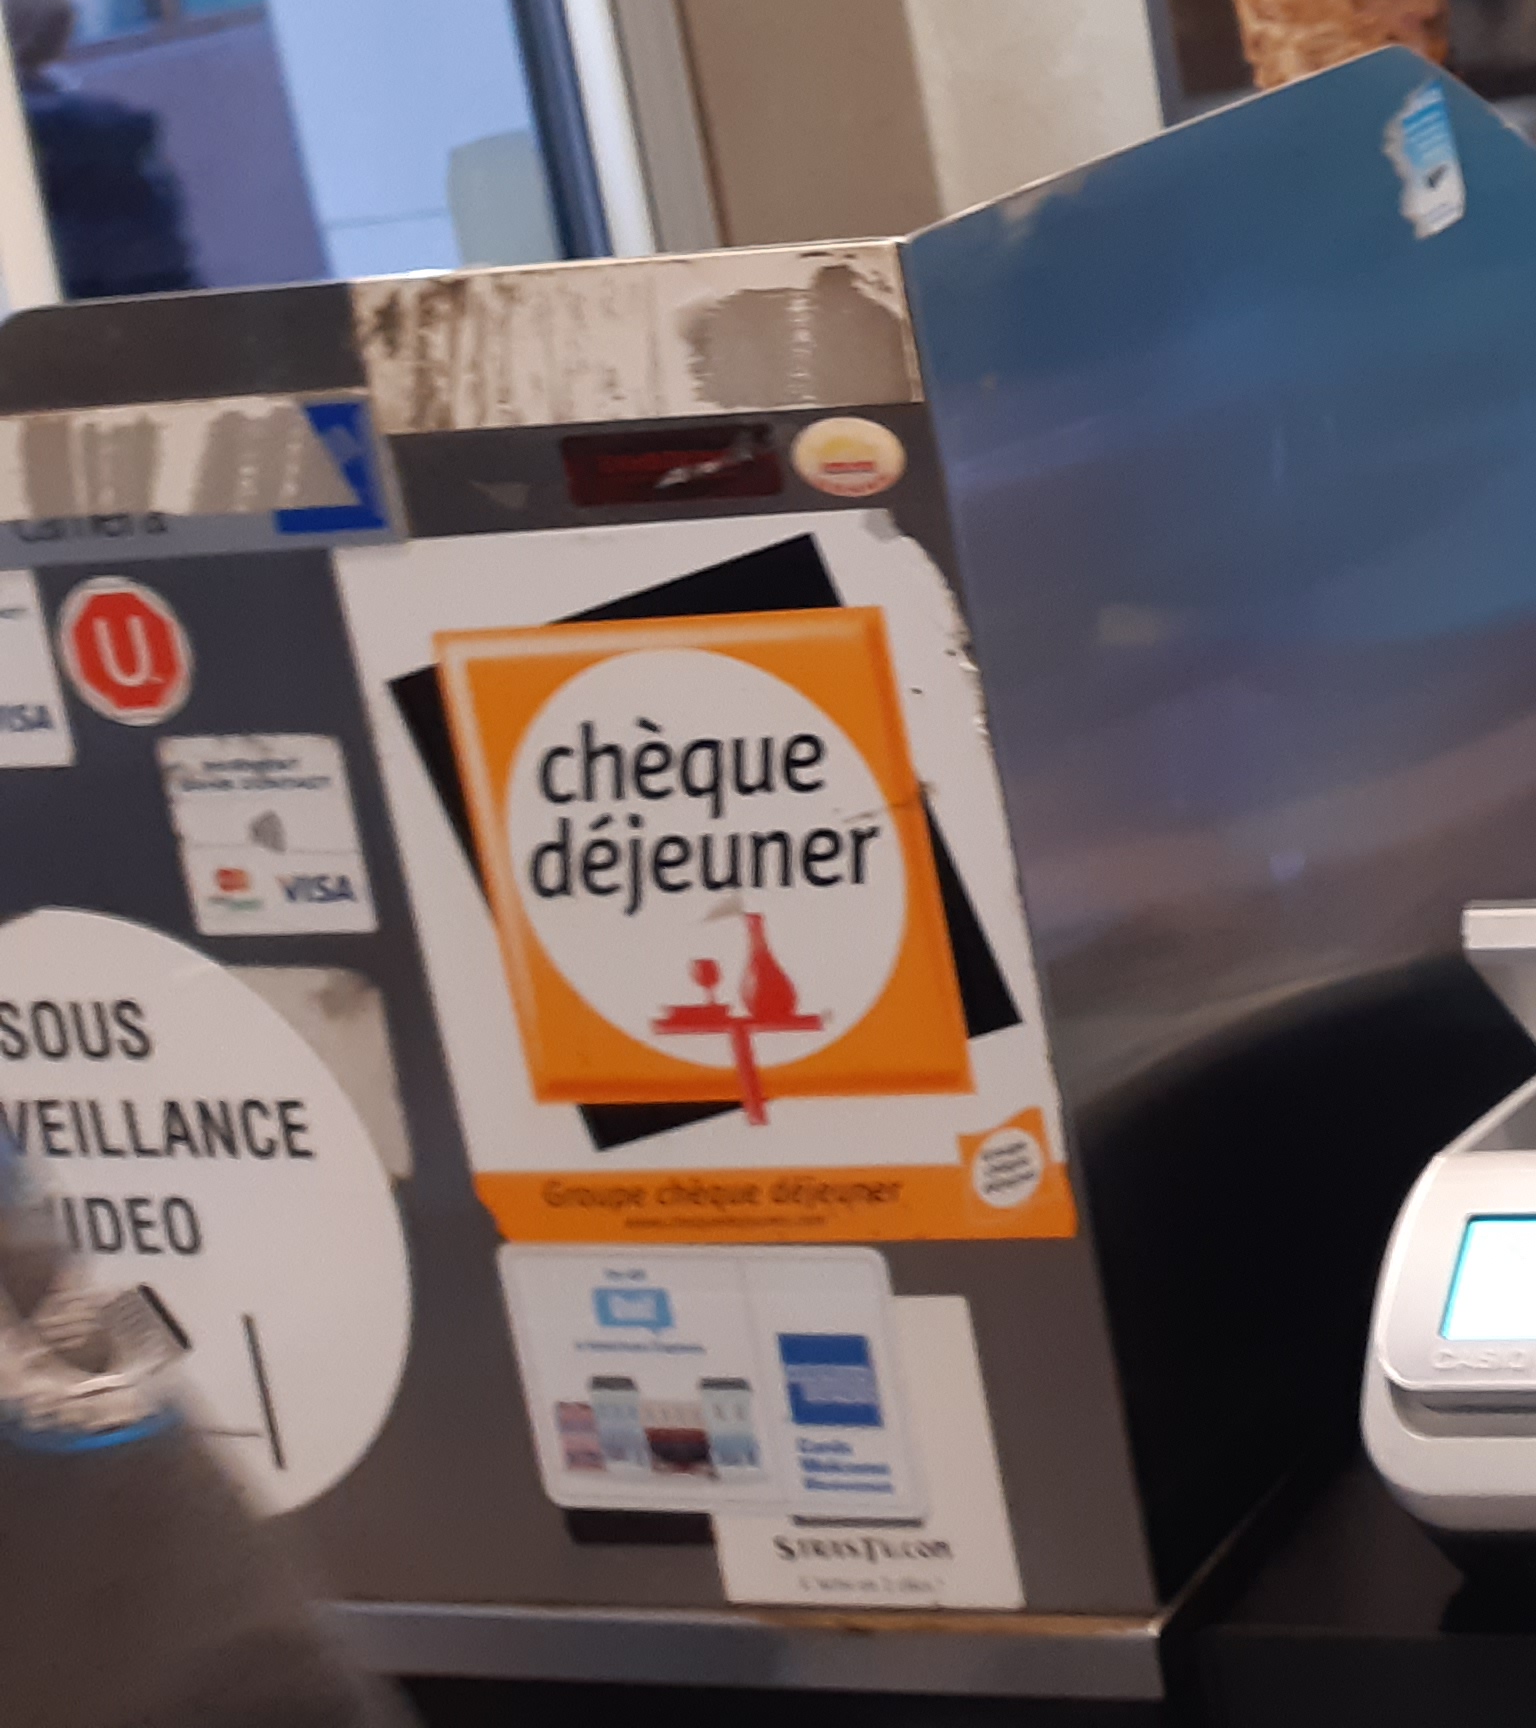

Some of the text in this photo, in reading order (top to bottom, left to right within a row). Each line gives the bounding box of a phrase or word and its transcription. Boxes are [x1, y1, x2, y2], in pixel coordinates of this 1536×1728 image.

[538, 718, 827, 817] chèque
[280, 875, 356, 903] VISA
[530, 814, 880, 915] déjeuner
[0, 998, 153, 1063] SOUS
[0, 1098, 316, 1160] VEILLANCE
[60, 1195, 202, 1257] IDEO
